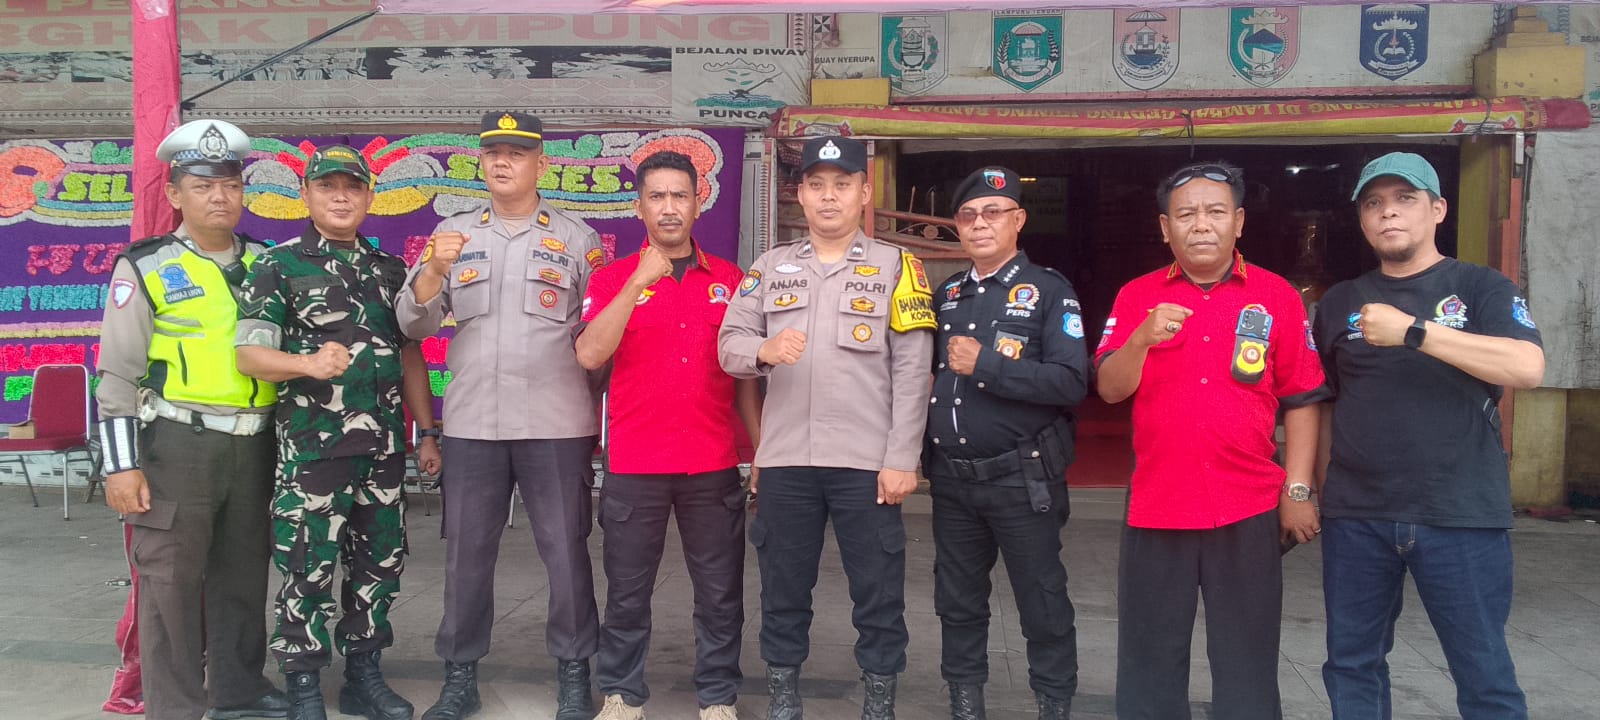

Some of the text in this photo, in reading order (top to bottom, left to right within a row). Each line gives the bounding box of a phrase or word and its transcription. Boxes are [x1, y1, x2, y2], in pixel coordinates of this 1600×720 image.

[307, 15, 770, 42] LAMPUNG
[675, 47, 808, 56] BEJALAN DIWAY
[838, 56, 875, 64] NYERUPA
[532, 249, 569, 267] POLRI
[769, 279, 808, 291] ANJAS
[844, 281, 886, 294] POLRI
[1006, 309, 1031, 318] PERS
